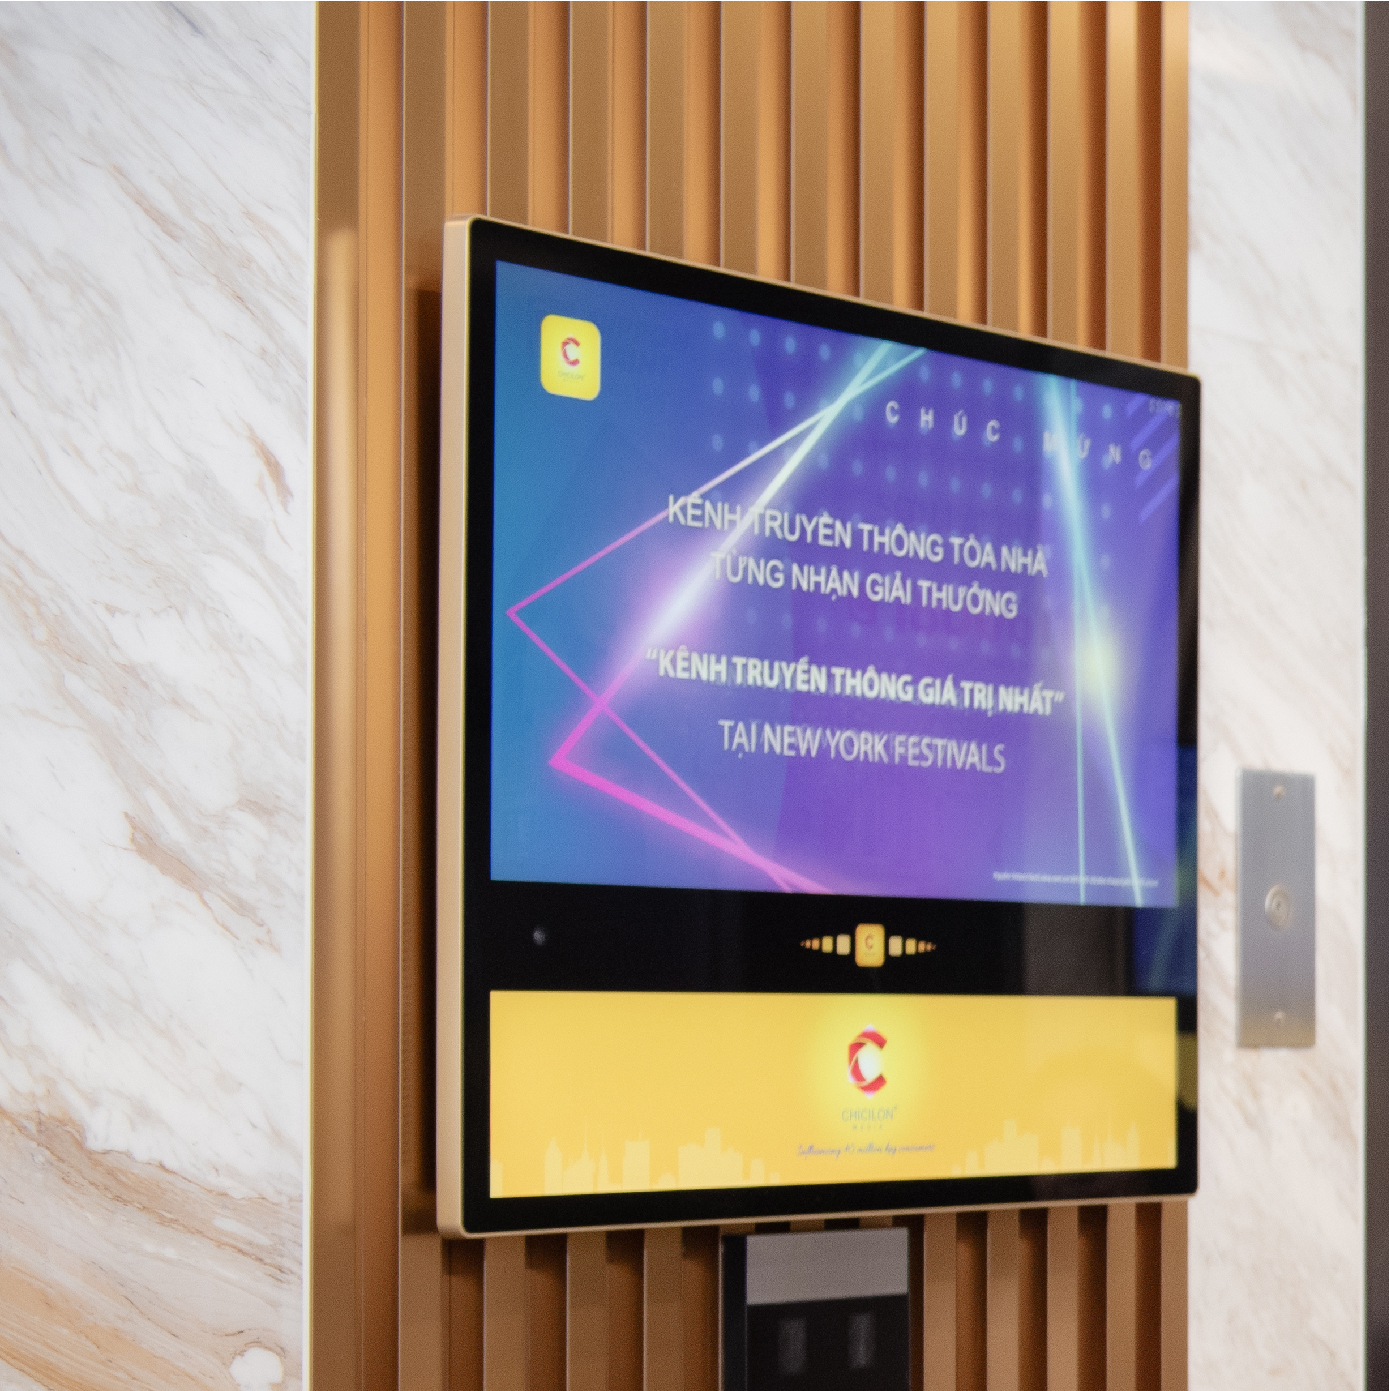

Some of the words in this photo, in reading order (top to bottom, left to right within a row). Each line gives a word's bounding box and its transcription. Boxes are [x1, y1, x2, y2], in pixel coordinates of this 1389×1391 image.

[885, 400, 1000, 442] CHÚC
[667, 494, 743, 531] KÊNH
[859, 522, 945, 563] THÔNG
[949, 533, 997, 570] TÒA
[1001, 542, 1049, 578] NHÀ
[792, 563, 860, 602] NHẬN
[866, 571, 912, 605] GIẢI
[918, 579, 1019, 620] THƯỞNG
[831, 664, 913, 701] THÔNG
[918, 674, 957, 706] GIÁ
[960, 681, 994, 718] TRỊ
[719, 719, 756, 758] TẠI
[764, 723, 825, 758] NEW
[825, 728, 889, 765] YORK
[893, 734, 1007, 774] FESTIVALS
